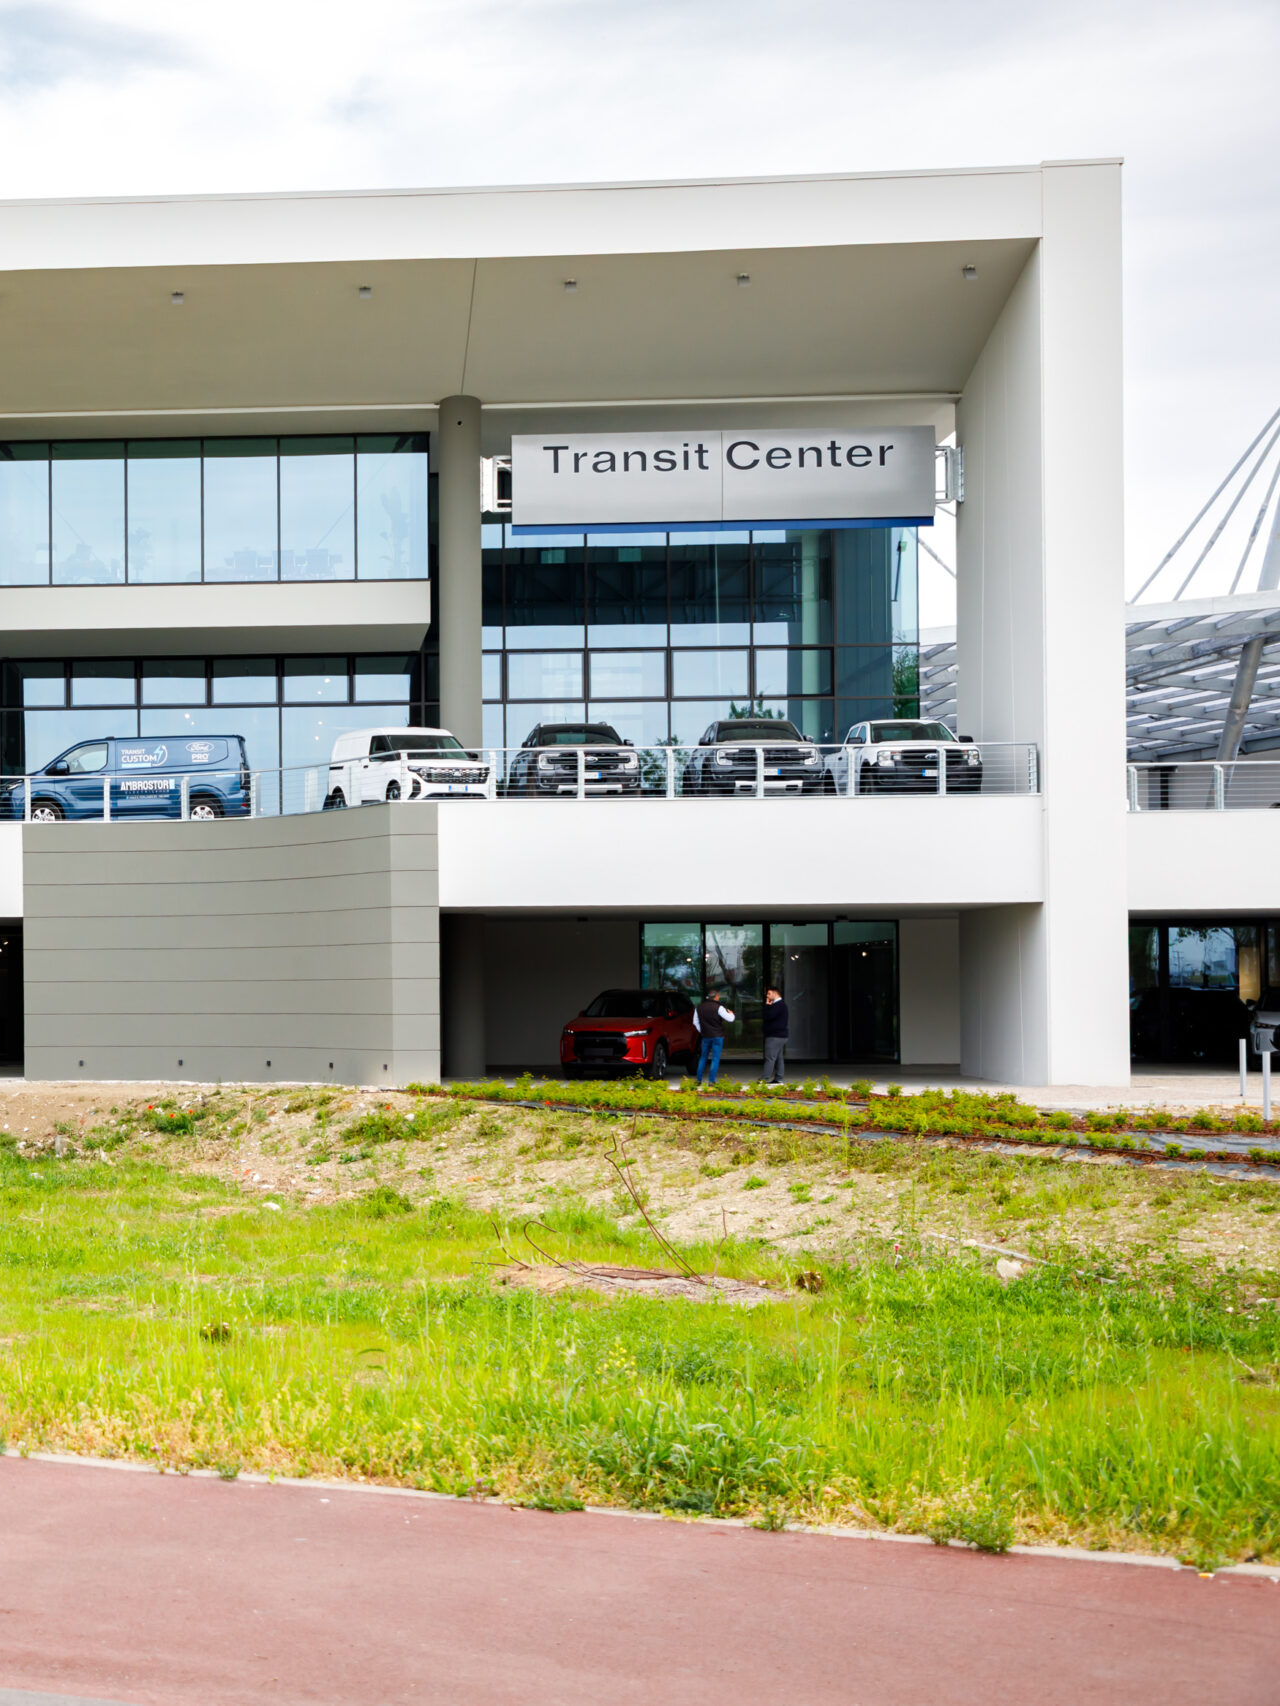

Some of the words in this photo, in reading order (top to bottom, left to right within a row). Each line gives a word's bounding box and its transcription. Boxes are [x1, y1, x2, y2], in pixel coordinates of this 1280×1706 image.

[542, 443, 709, 474] Transit
[726, 440, 895, 470] Center
[121, 754, 158, 763] CUSTOM
